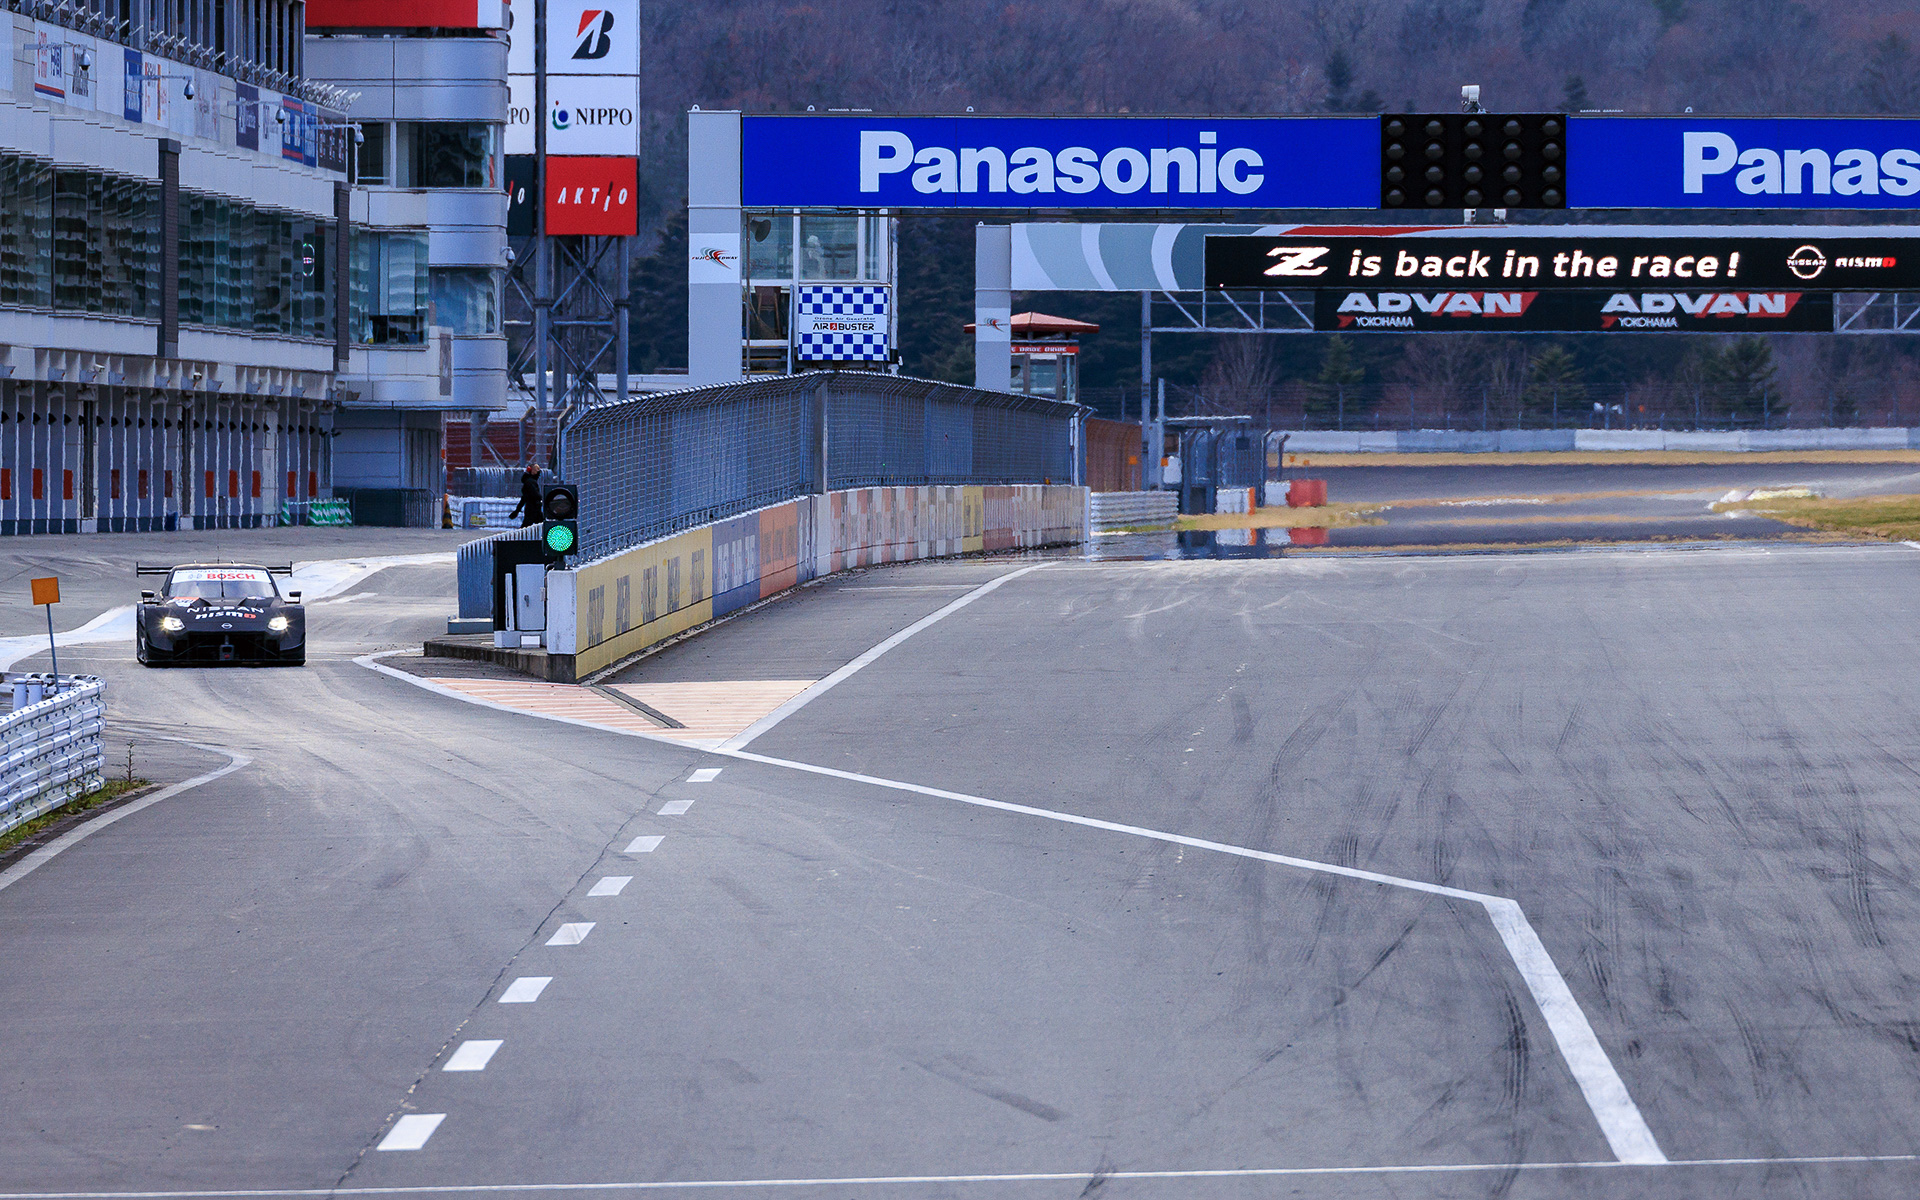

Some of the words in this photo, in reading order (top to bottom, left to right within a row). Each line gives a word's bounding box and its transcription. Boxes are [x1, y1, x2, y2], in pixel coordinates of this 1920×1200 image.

[576, 108, 633, 126] NIPPO
[860, 130, 1265, 194] Panasonic
[557, 180, 628, 212] AKTIO
[1349, 249, 1381, 277] is
[1394, 249, 1491, 277] back
[1502, 249, 1540, 277] in
[1552, 250, 1618, 278] the
[1786, 258, 1827, 266] NISSAN
[1336, 292, 1522, 314] ADVAN
[1600, 293, 1786, 314] ADVAN
[813, 323, 829, 331] AIR
[838, 323, 875, 331] BUSTER
[1355, 315, 1414, 328] YOKOHAMA
[1617, 316, 1678, 328] YOKOHAMA
[186, 606, 265, 614] NISSAN
